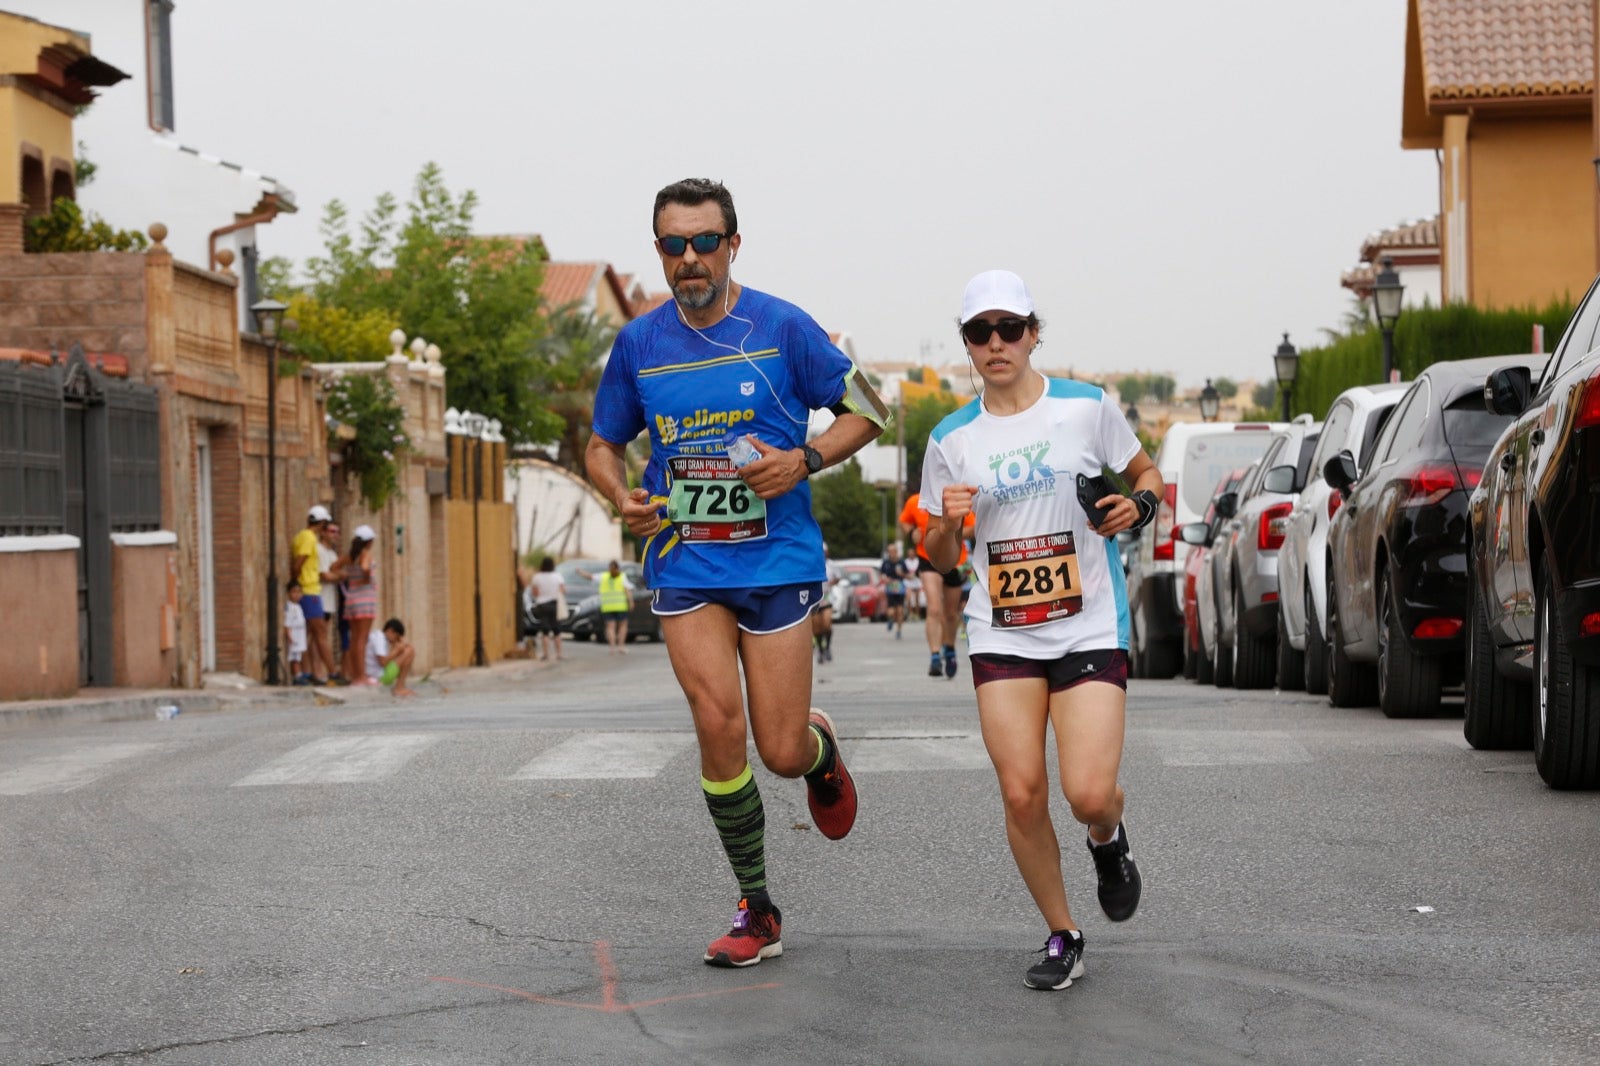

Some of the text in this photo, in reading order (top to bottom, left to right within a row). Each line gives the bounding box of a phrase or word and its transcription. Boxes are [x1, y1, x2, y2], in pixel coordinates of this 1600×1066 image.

[682, 408, 755, 428] olimpo
[681, 428, 726, 439] deportes
[679, 445, 702, 454] TRAIL
[705, 444, 713, 453] &
[988, 440, 1051, 462] SALOBREÑA
[688, 459, 704, 470] GRAN
[705, 459, 729, 470] PREMIO
[989, 447, 1054, 489] 10K
[993, 477, 1056, 498] CAMPEONATO
[683, 484, 750, 515] 726
[1000, 542, 1014, 553] GRAN
[1014, 538, 1038, 552] PREMIO
[1038, 536, 1048, 549] DE
[1048, 534, 1068, 547] FONDO
[1026, 549, 1054, 559] CRUZCAMPO
[998, 561, 1072, 599] 2281
